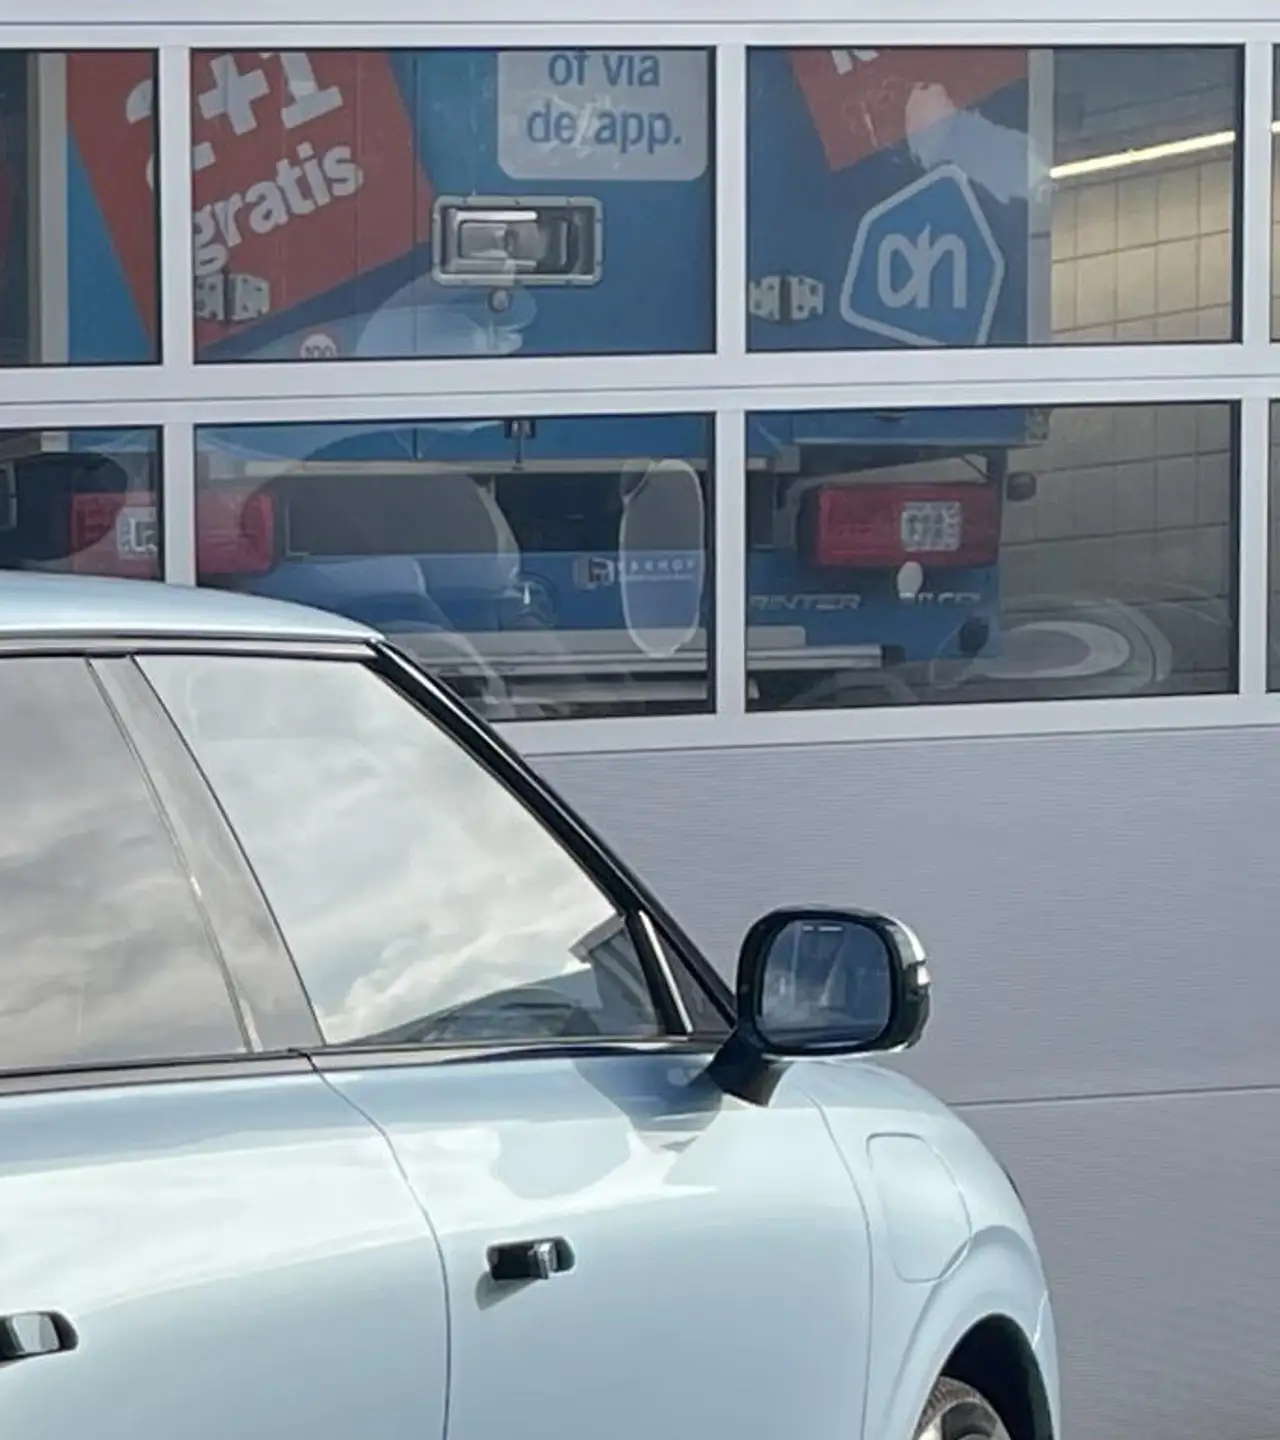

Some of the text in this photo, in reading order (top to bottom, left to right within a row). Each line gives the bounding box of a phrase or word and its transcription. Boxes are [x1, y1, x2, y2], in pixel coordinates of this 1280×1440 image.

[548, 51, 660, 87] of via
[527, 100, 683, 154] de app.
[192, 141, 364, 276] gratis
